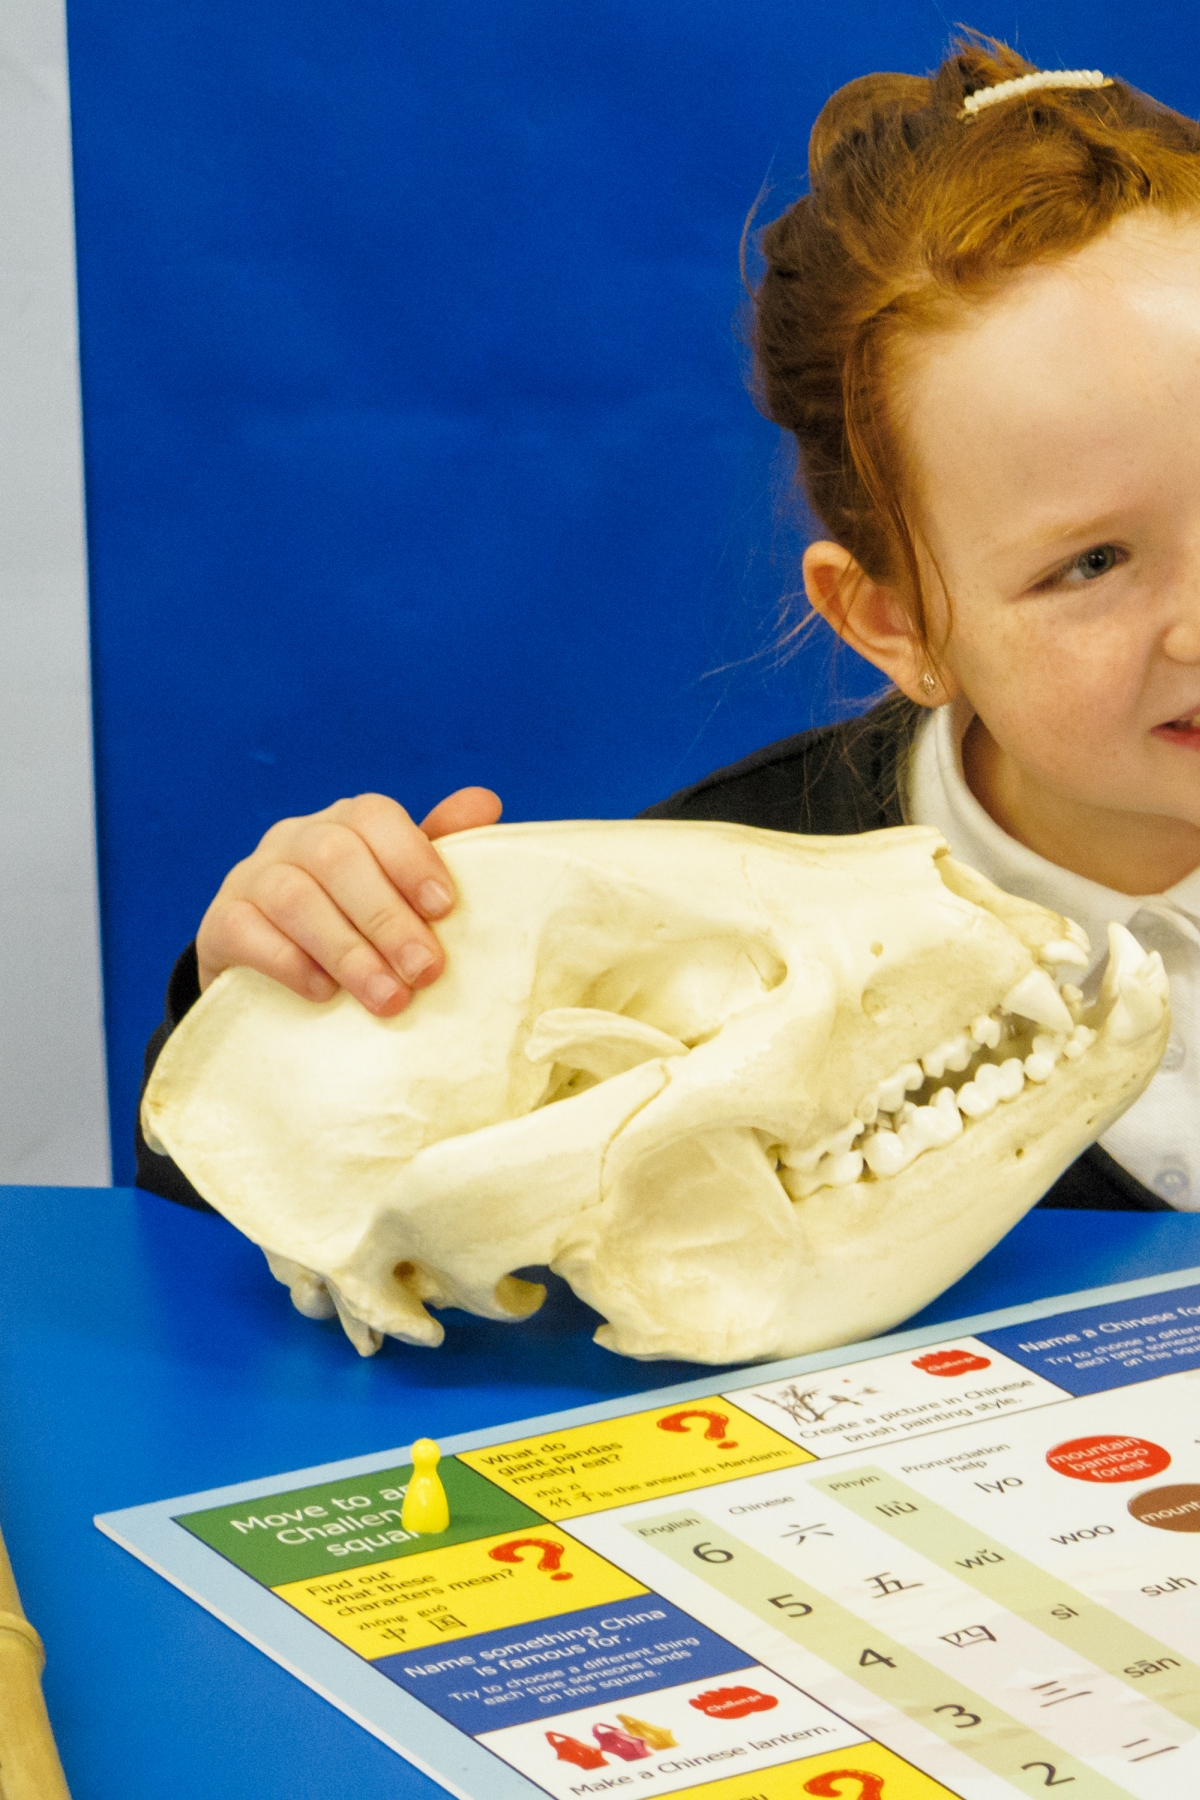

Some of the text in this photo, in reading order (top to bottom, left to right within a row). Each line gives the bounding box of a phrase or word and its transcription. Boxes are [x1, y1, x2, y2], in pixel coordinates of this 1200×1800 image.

[1018, 1334, 1081, 1353] Name
[1082, 1329, 1098, 1338] a
[1098, 1312, 1177, 1333] Chinese
[799, 1380, 1034, 1438] Create a picture in Chinese
[843, 1427, 897, 1442] brush
[900, 1409, 973, 1431] painting
[481, 1443, 566, 1465] What do
[498, 1443, 623, 1476] giant pandas
[512, 1454, 620, 1485] mostly eat?
[950, 1461, 987, 1473] help
[1049, 1438, 1140, 1464] mountain
[1068, 1448, 1149, 1472] bamboo
[1091, 1459, 1151, 1479] forest
[638, 1444, 1011, 1537] English Chinese Pinyin Pronunciation
[230, 1496, 372, 1534] Move to
[276, 1509, 402, 1545] Challen
[693, 1542, 734, 1564] 6
[780, 1523, 834, 1546] 六
[974, 1478, 1023, 1494] lyo
[326, 1529, 420, 1556] squar
[306, 1571, 391, 1596] Find out
[768, 1594, 813, 1618] 5
[867, 1573, 922, 1598] 五
[1051, 1526, 1115, 1545] woo
[322, 1576, 436, 1606] what these
[337, 1568, 514, 1616] characters mean?
[859, 1648, 897, 1668] 4
[939, 1625, 997, 1648] 四
[1141, 1577, 1197, 1597] suh
[404, 1610, 667, 1678] Name something China
[473, 1666, 497, 1676] is
[498, 1644, 586, 1670] famous
[448, 1690, 480, 1701] Try
[482, 1685, 503, 1694] to
[506, 1670, 565, 1688] choose
[583, 1647, 654, 1670] different
[654, 1637, 700, 1652] thing
[933, 1704, 981, 1728] 3
[1031, 1680, 1093, 1708] 三
[1123, 1658, 1181, 1678] sān
[570, 1727, 837, 1796] Make a Chinese lantern.
[1021, 1762, 1075, 1787] 2
[1122, 1738, 1179, 1762] 二
